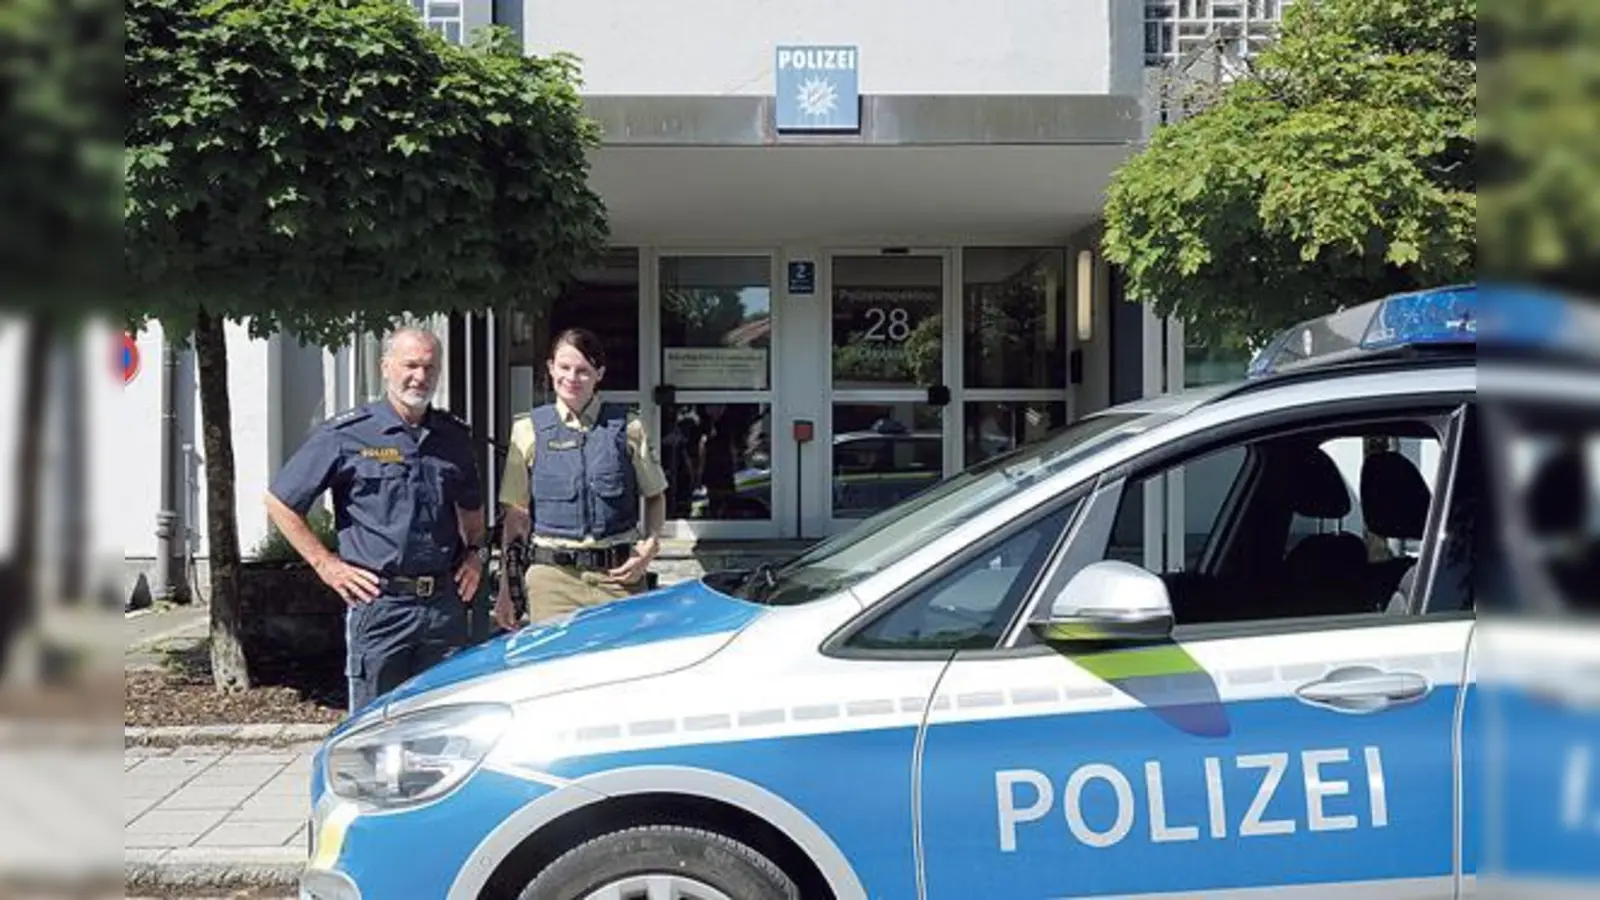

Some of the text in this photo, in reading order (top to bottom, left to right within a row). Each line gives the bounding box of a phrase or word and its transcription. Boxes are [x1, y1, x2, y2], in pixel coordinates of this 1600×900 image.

[778, 49, 855, 69] POLIZEI
[864, 308, 909, 341] 28
[995, 746, 1388, 852] POLIZEI
